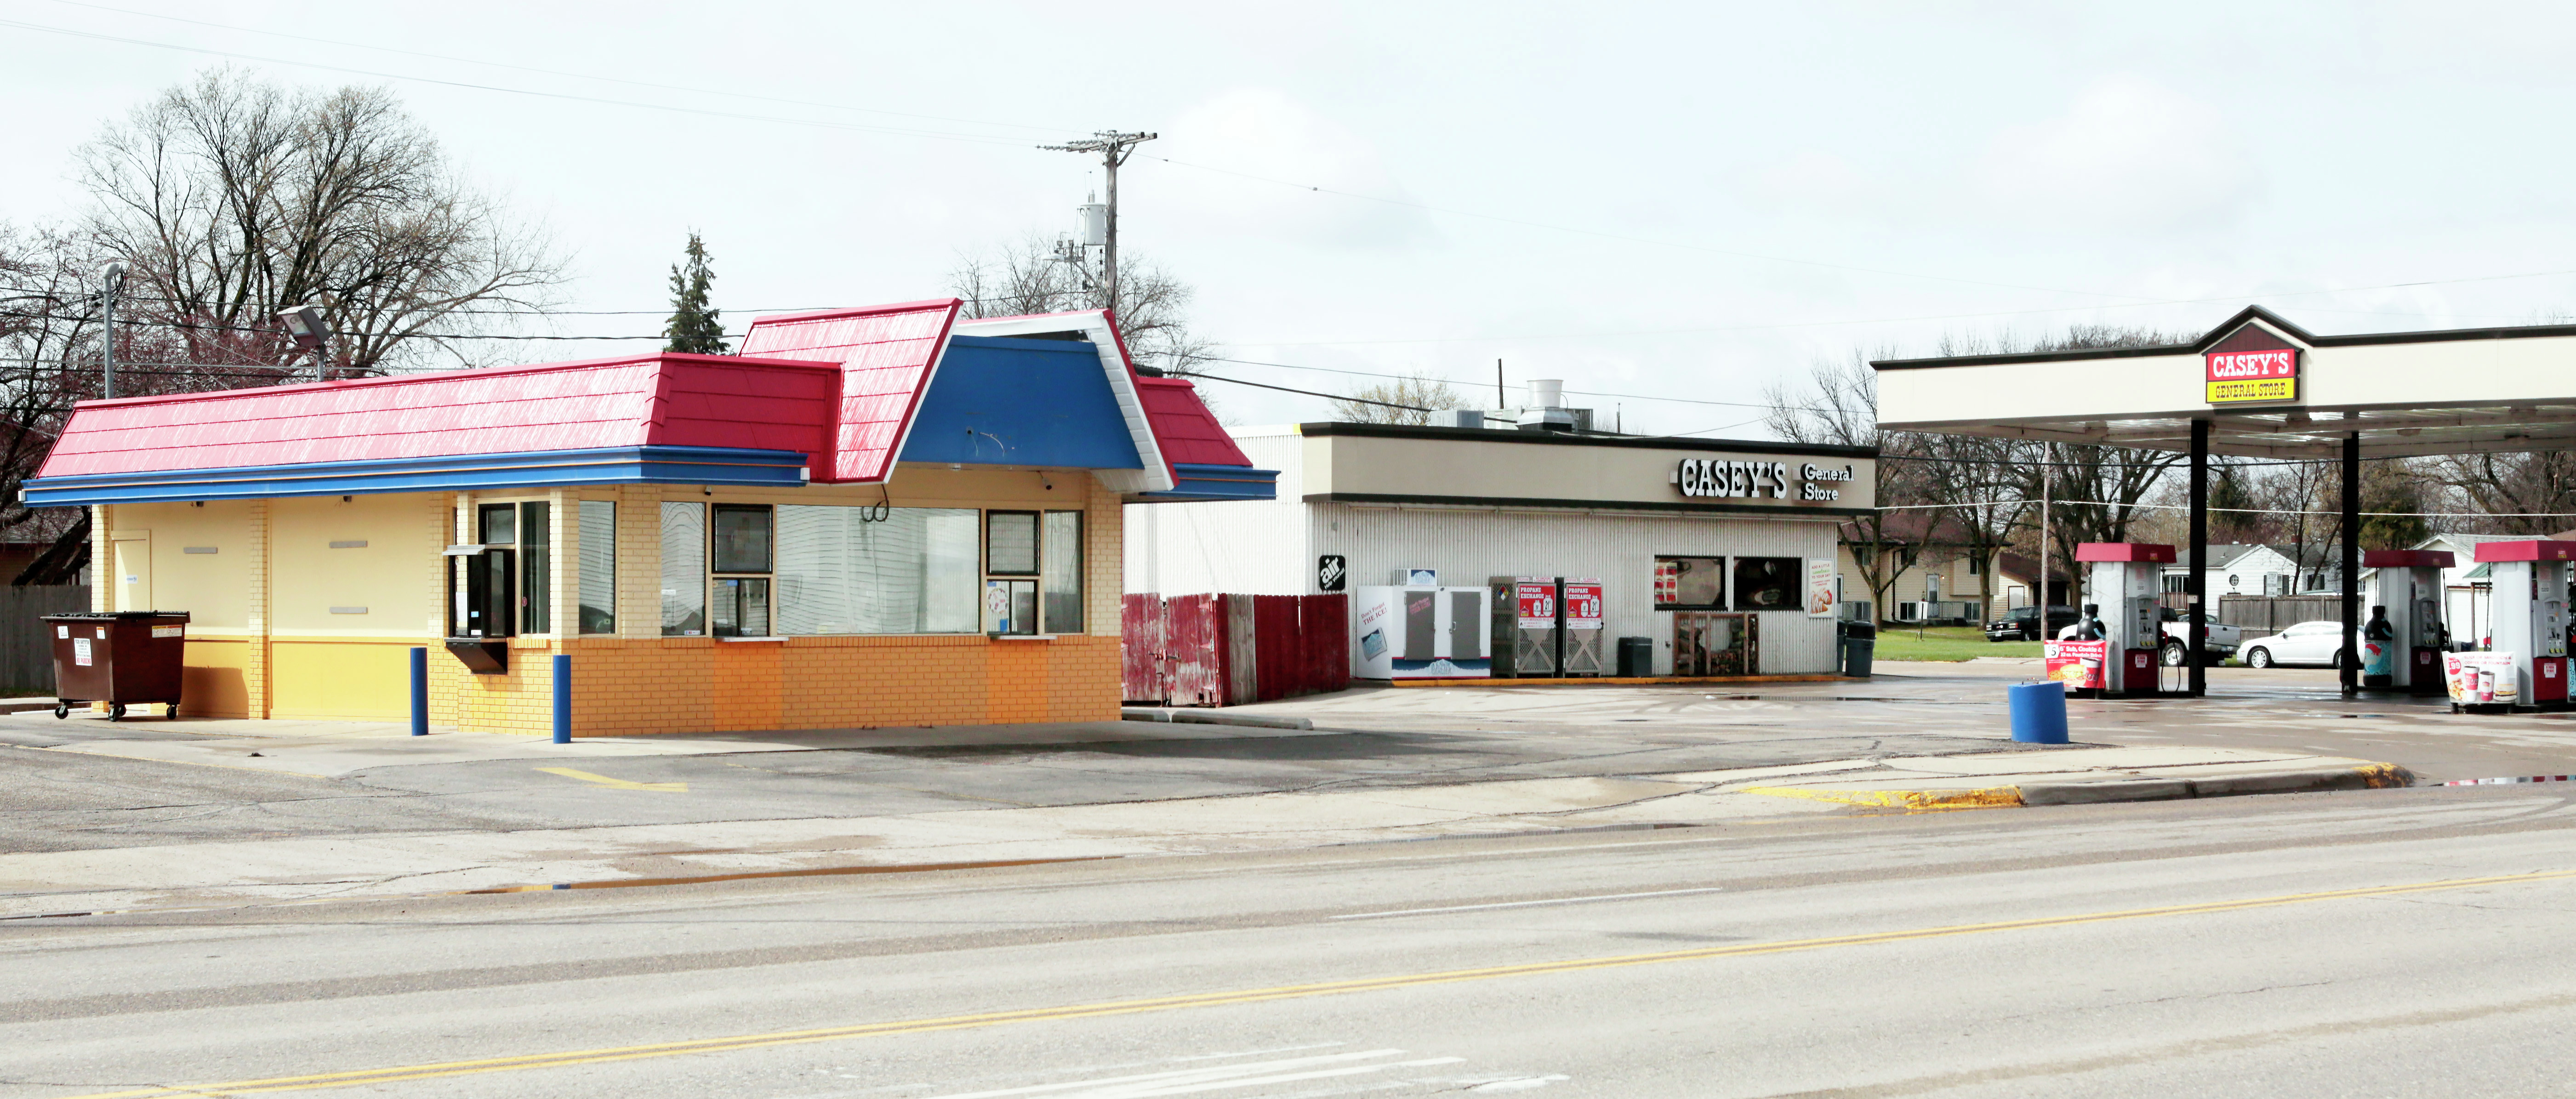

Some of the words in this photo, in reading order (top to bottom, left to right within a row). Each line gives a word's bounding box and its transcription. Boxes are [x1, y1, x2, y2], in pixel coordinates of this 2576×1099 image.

[2213, 353, 2289, 377] CASEY'S
[2216, 384, 2256, 399] GENERAL
[2259, 382, 2285, 396] STORE
[1681, 459, 1787, 499] CASEY'S
[1804, 463, 1855, 482] General
[1804, 483, 1839, 501] Store
[1320, 557, 1340, 584] air
[1361, 610, 1372, 619] Don't
[1372, 602, 1385, 612] Forget
[1363, 615, 1375, 625] THE
[1376, 607, 1387, 618] ICE!
